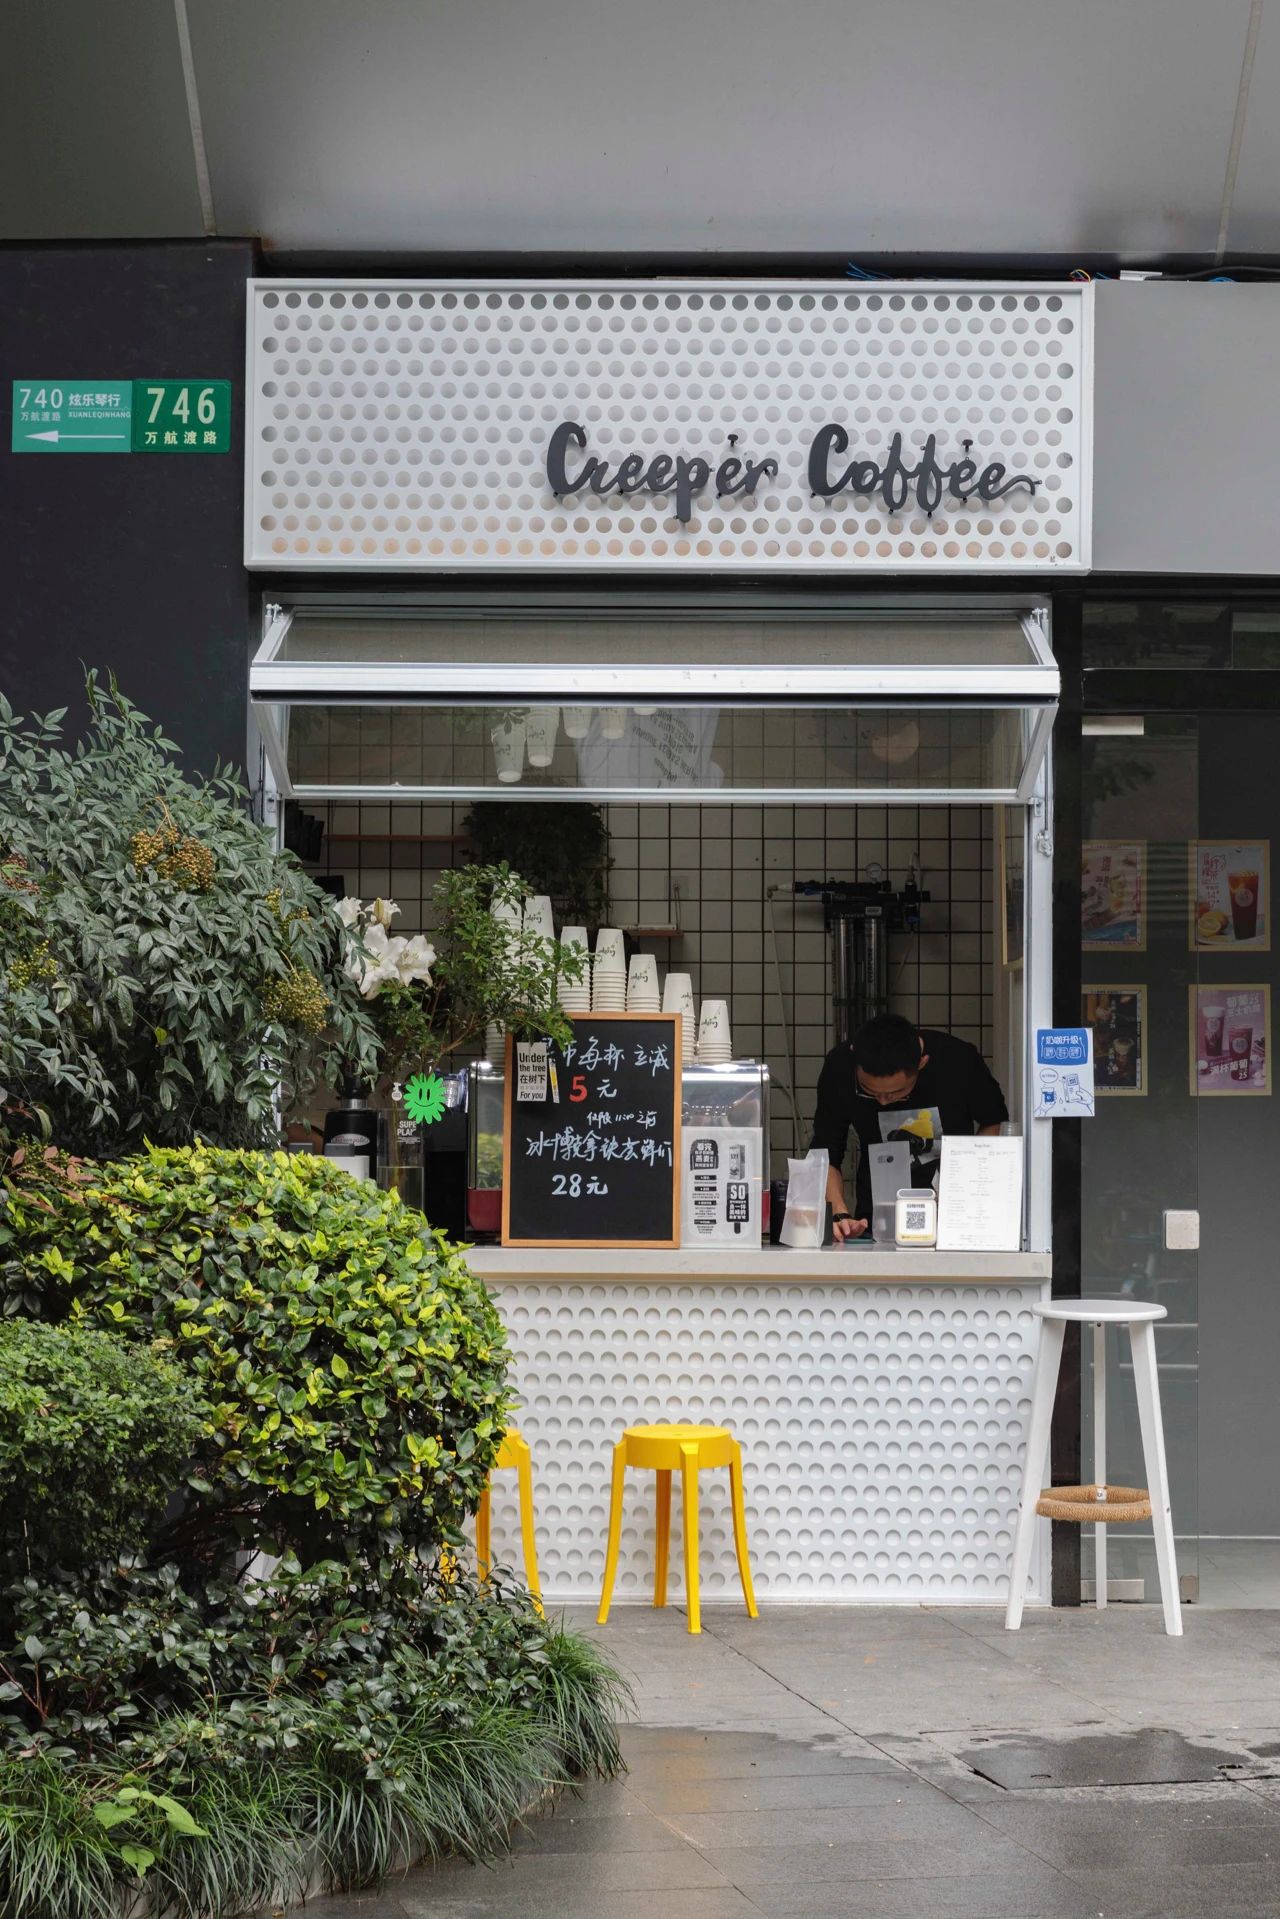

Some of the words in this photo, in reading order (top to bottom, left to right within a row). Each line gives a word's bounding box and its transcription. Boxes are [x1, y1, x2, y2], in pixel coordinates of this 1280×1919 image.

[20, 388, 63, 409] 740
[68, 393, 121, 407] 炫乐琴行
[147, 387, 216, 424] 746
[20, 411, 61, 422] 万航渡路
[68, 411, 131, 419] XUANLEQINHANG
[145, 431, 217, 445] 万航渡路
[546, 421, 779, 524] Creeper
[808, 423, 1043, 517] Coffee
[519, 1053, 546, 1063] Under
[519, 1064, 531, 1072] the
[532, 1064, 546, 1072] tree
[519, 1074, 546, 1084] 在树下
[520, 1091, 531, 1099] For
[531, 1092, 544, 1101] you
[399, 1120, 417, 1129] SUPE
[551, 1173, 609, 1199] 28元
[730, 1184, 746, 1200] SO
